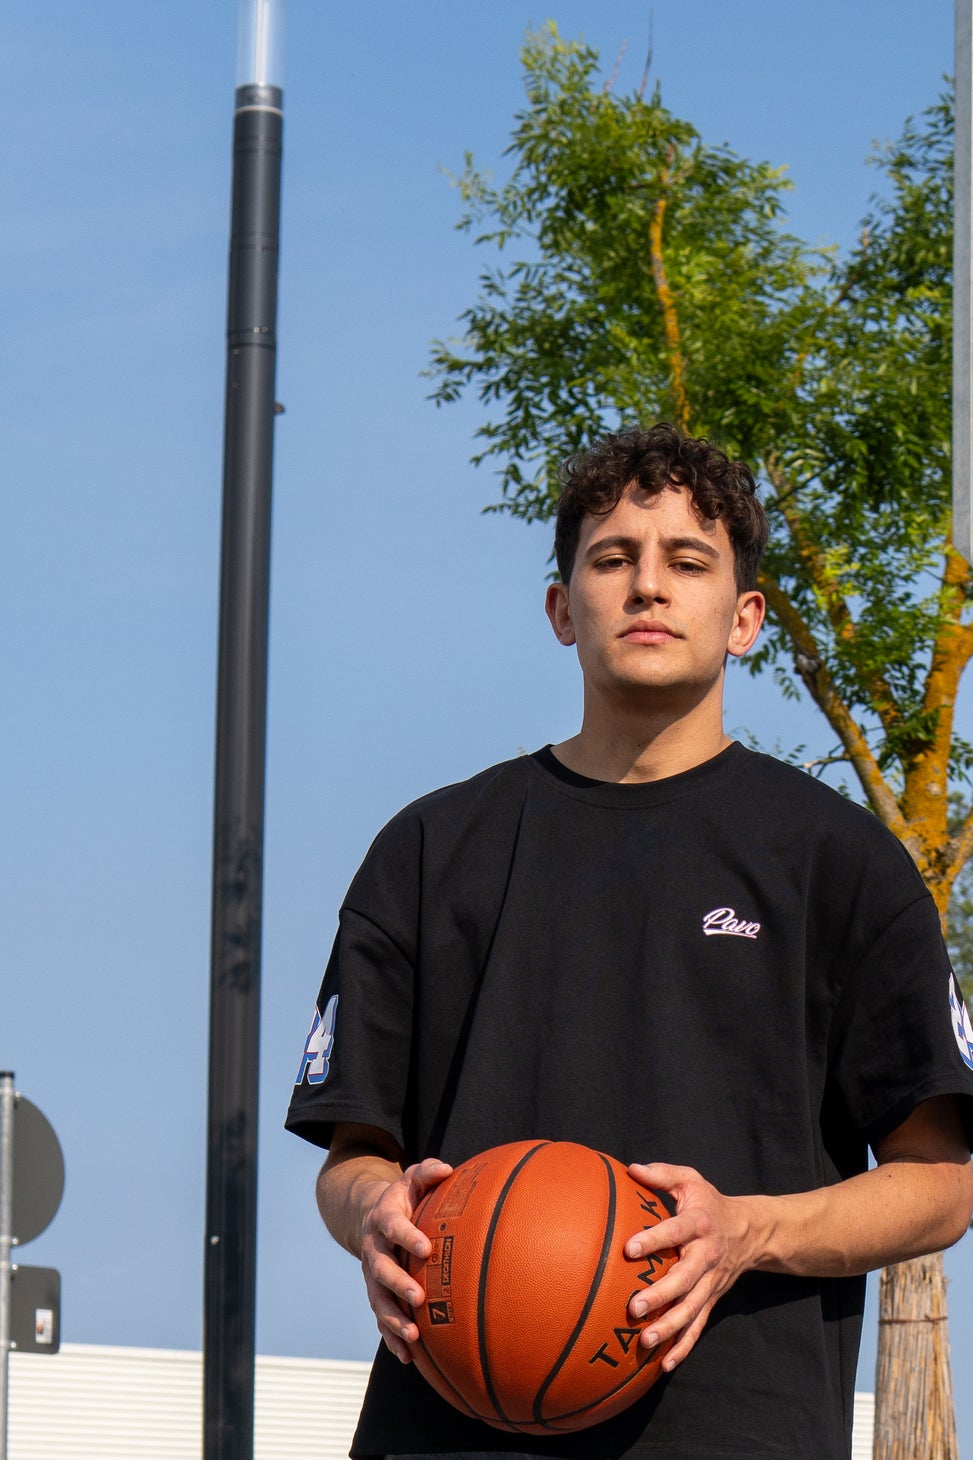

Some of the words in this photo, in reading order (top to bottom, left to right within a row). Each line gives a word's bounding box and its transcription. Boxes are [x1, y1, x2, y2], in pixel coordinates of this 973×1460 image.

[703, 907, 760, 937] Pavo
[293, 994, 339, 1085] 4
[588, 1190, 664, 1368] TAMK
[432, 1307, 446, 1320] 7
